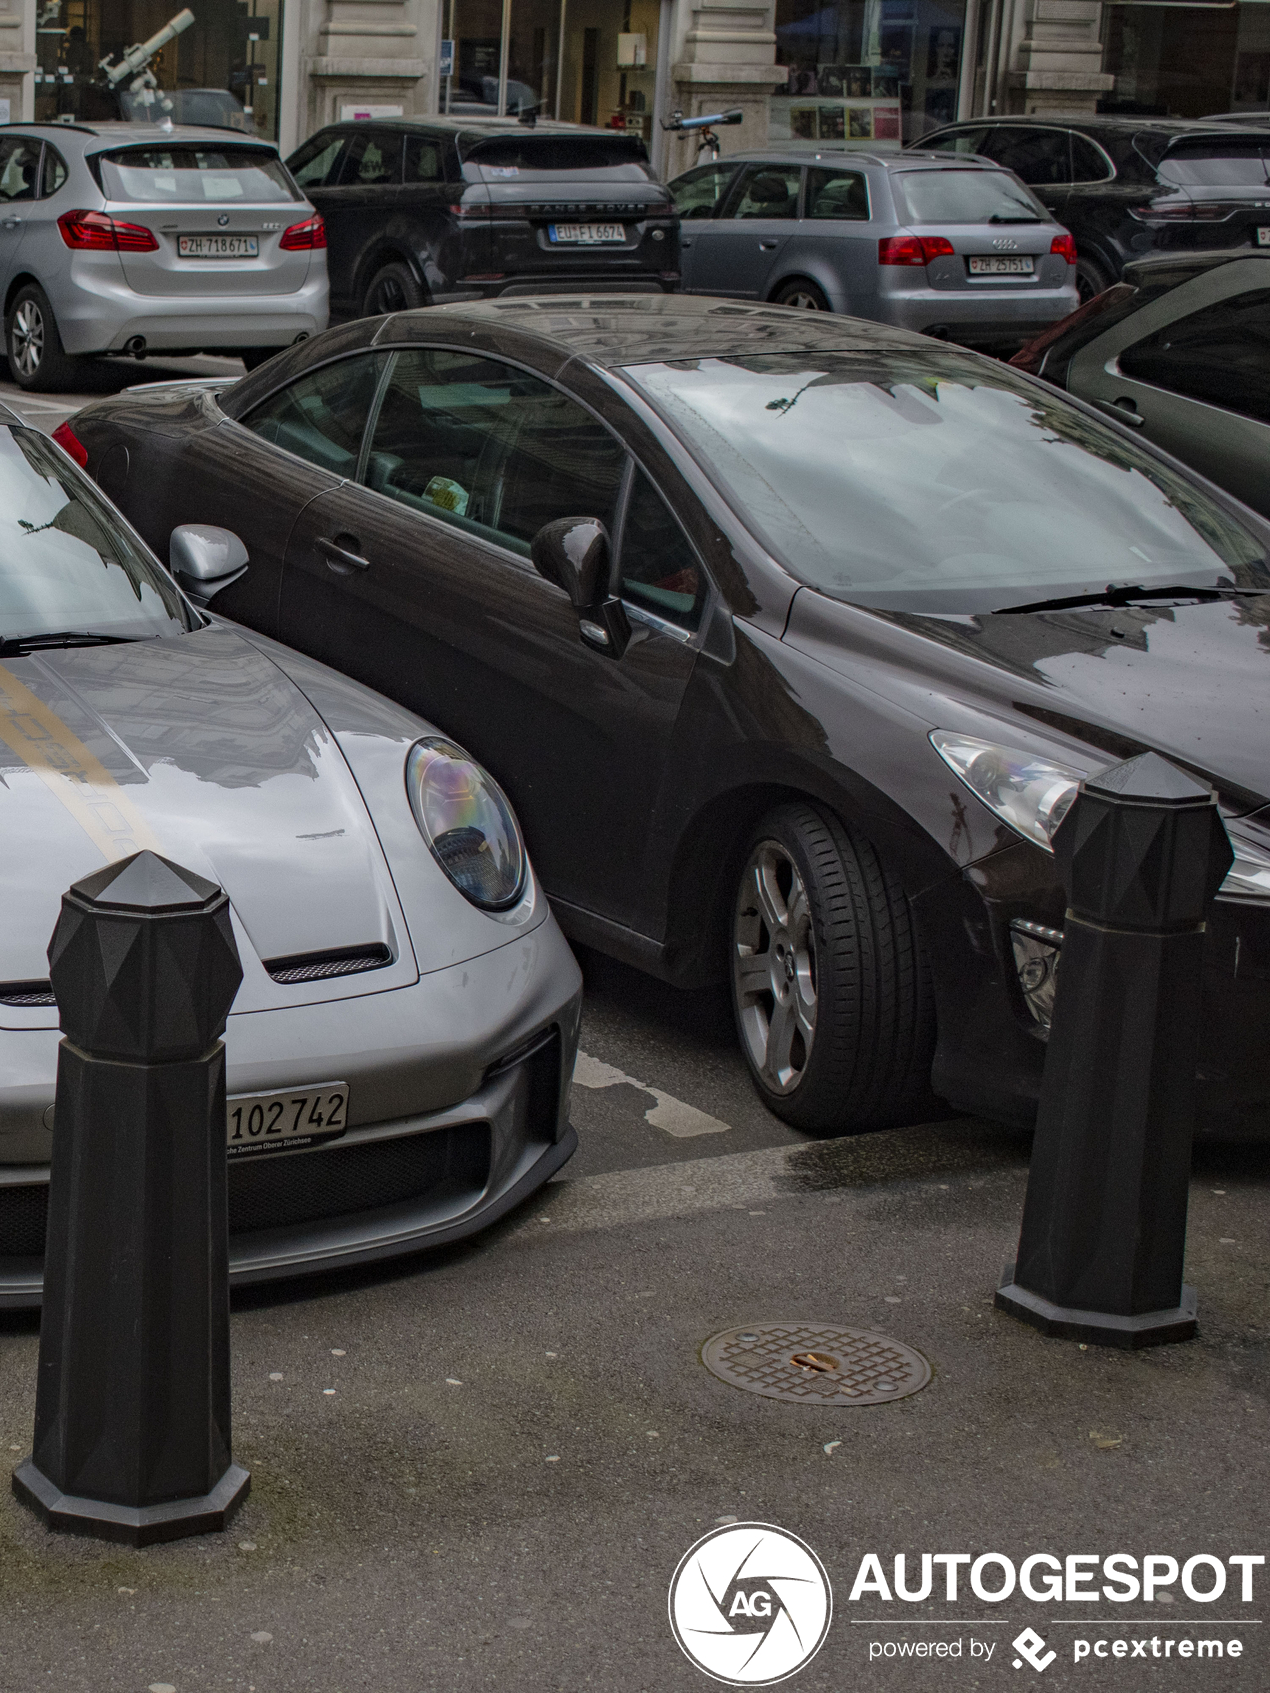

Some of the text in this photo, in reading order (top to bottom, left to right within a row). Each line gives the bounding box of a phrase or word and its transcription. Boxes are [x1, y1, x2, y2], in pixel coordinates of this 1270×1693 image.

[237, 1144, 263, 1153] Zentrum
[263, 1141, 283, 1150] Oberer
[283, 1136, 312, 1147] Zürichsee
